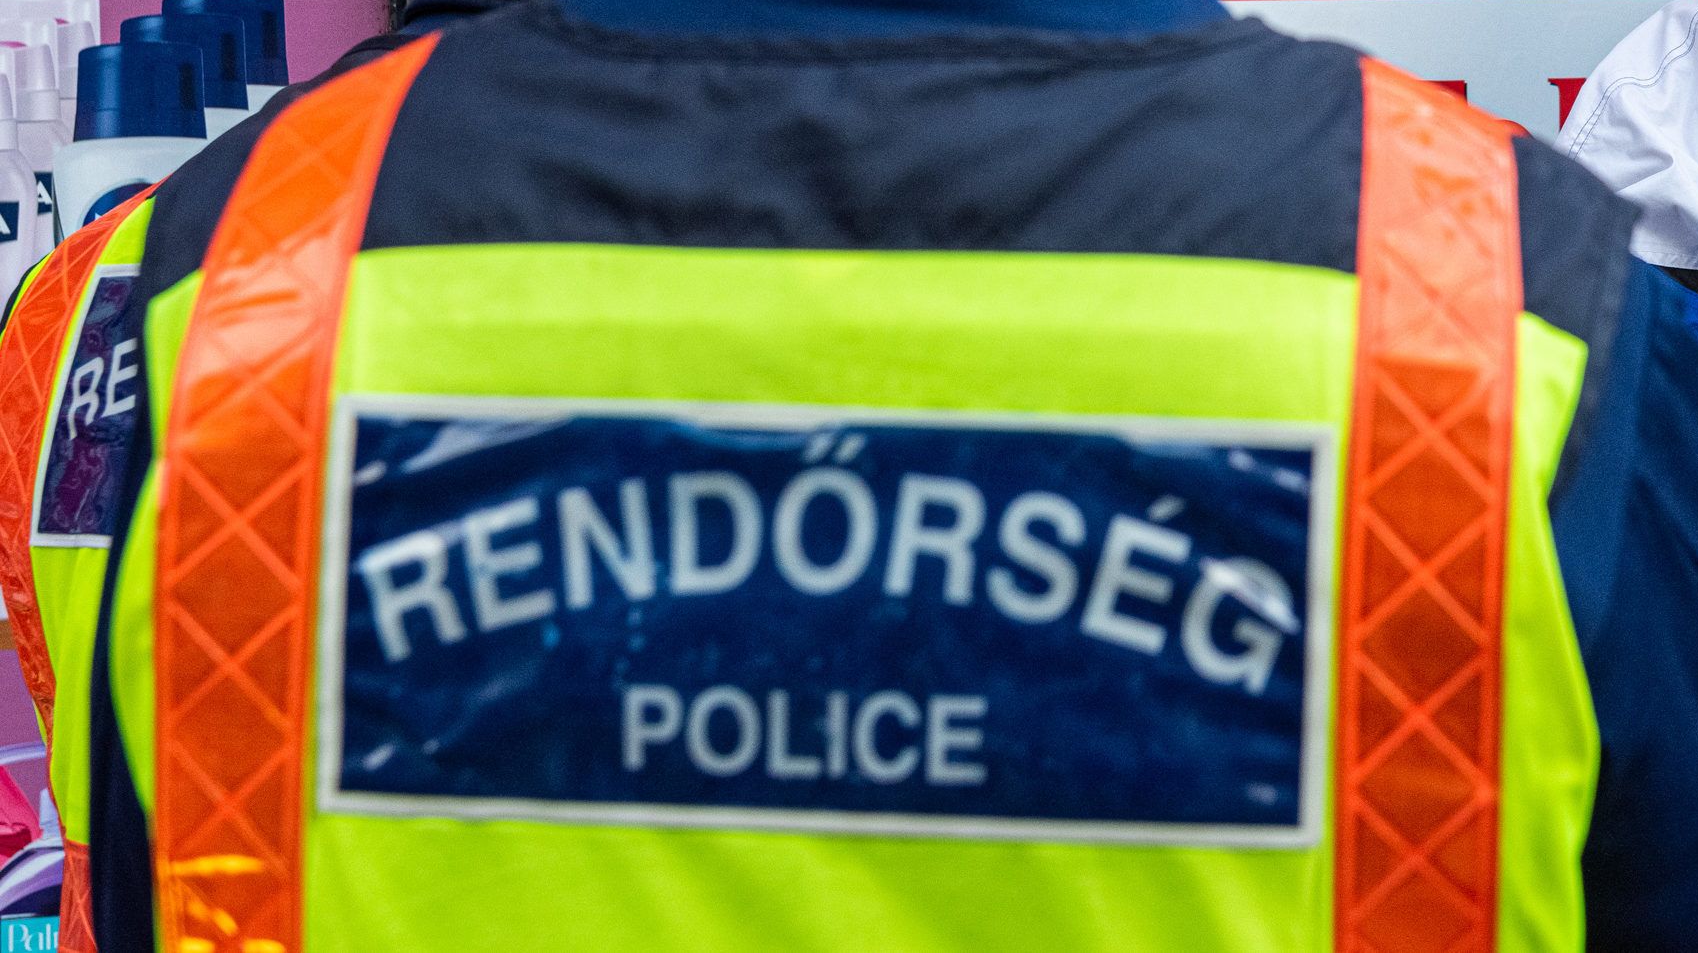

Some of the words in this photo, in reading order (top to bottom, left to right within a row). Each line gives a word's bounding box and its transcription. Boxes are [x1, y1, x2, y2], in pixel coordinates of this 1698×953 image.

[358, 432, 1302, 694] RENDŐRSÉG
[620, 683, 990, 784] POLICE
[8, 922, 58, 953] Pal
